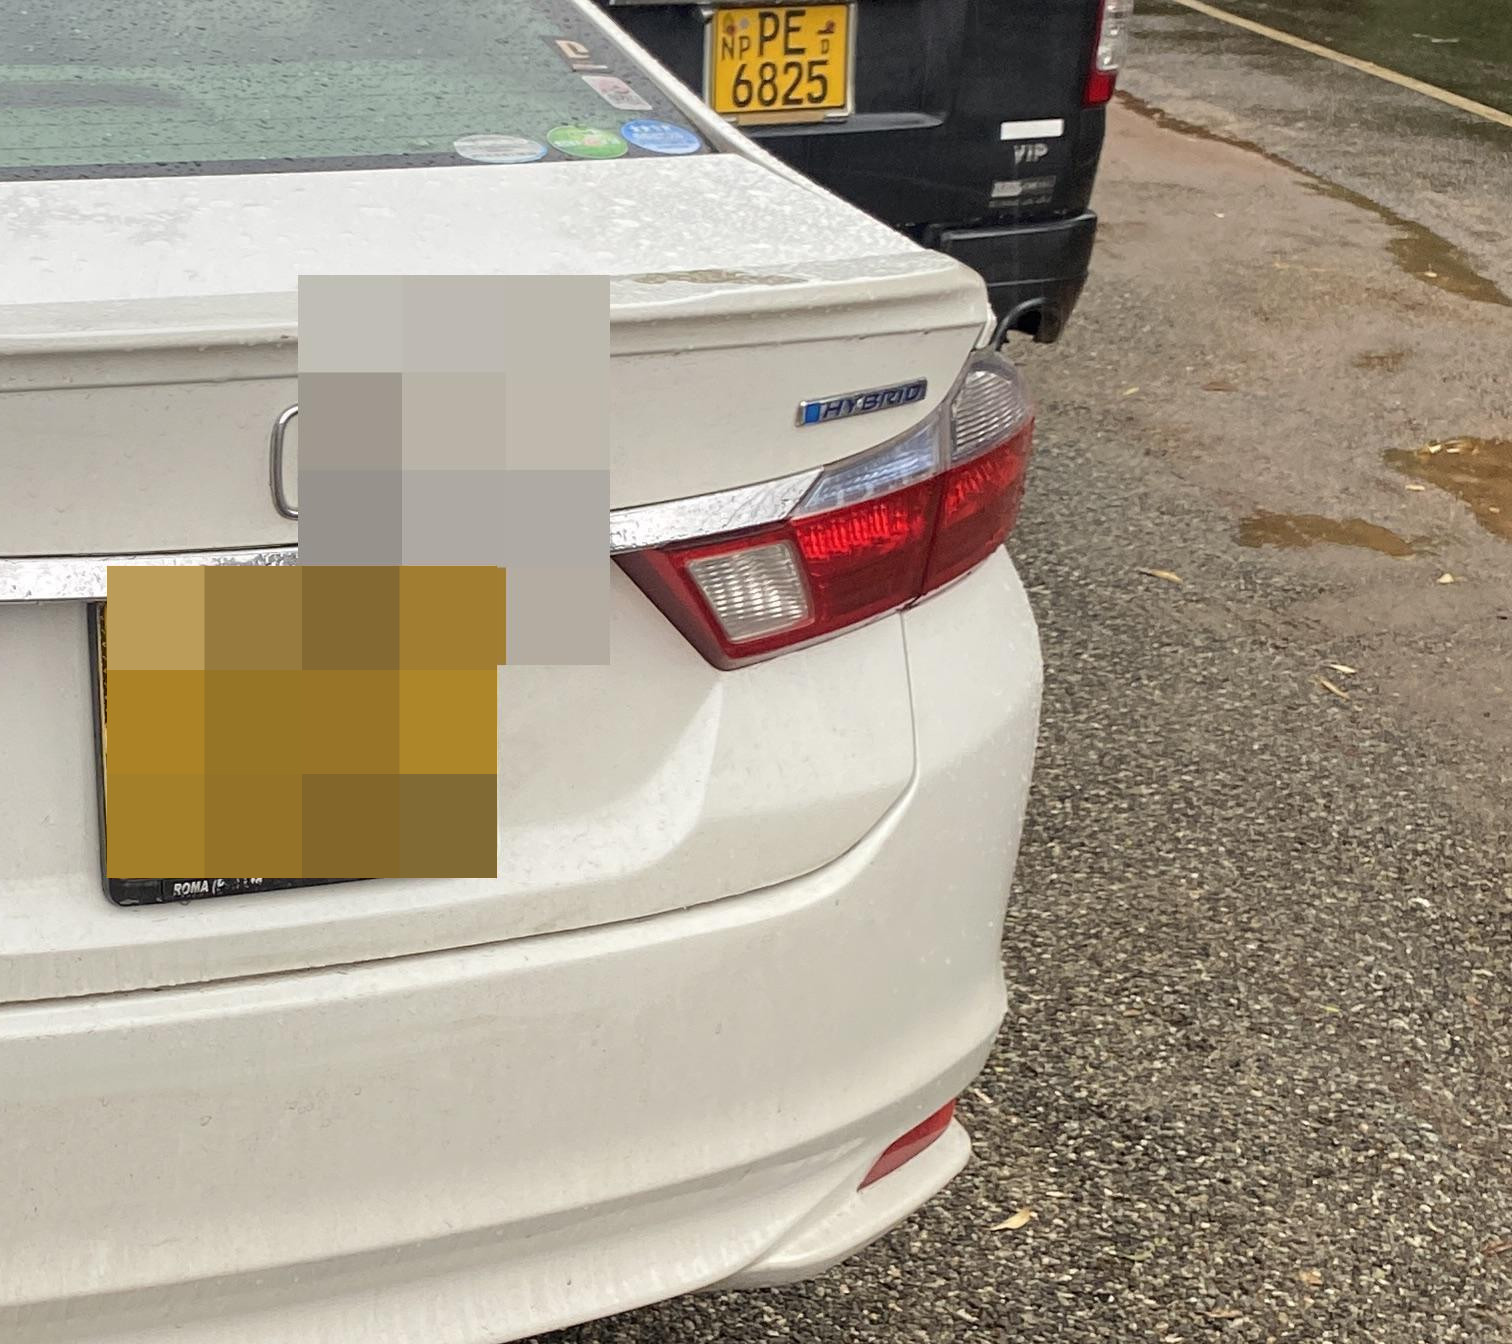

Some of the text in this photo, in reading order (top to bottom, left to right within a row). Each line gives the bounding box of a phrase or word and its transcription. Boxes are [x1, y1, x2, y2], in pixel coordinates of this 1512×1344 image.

[721, 9, 806, 61] NP PE
[732, 59, 829, 108] 6825
[1013, 143, 1049, 164] VIP
[822, 383, 923, 419] HYBRID
